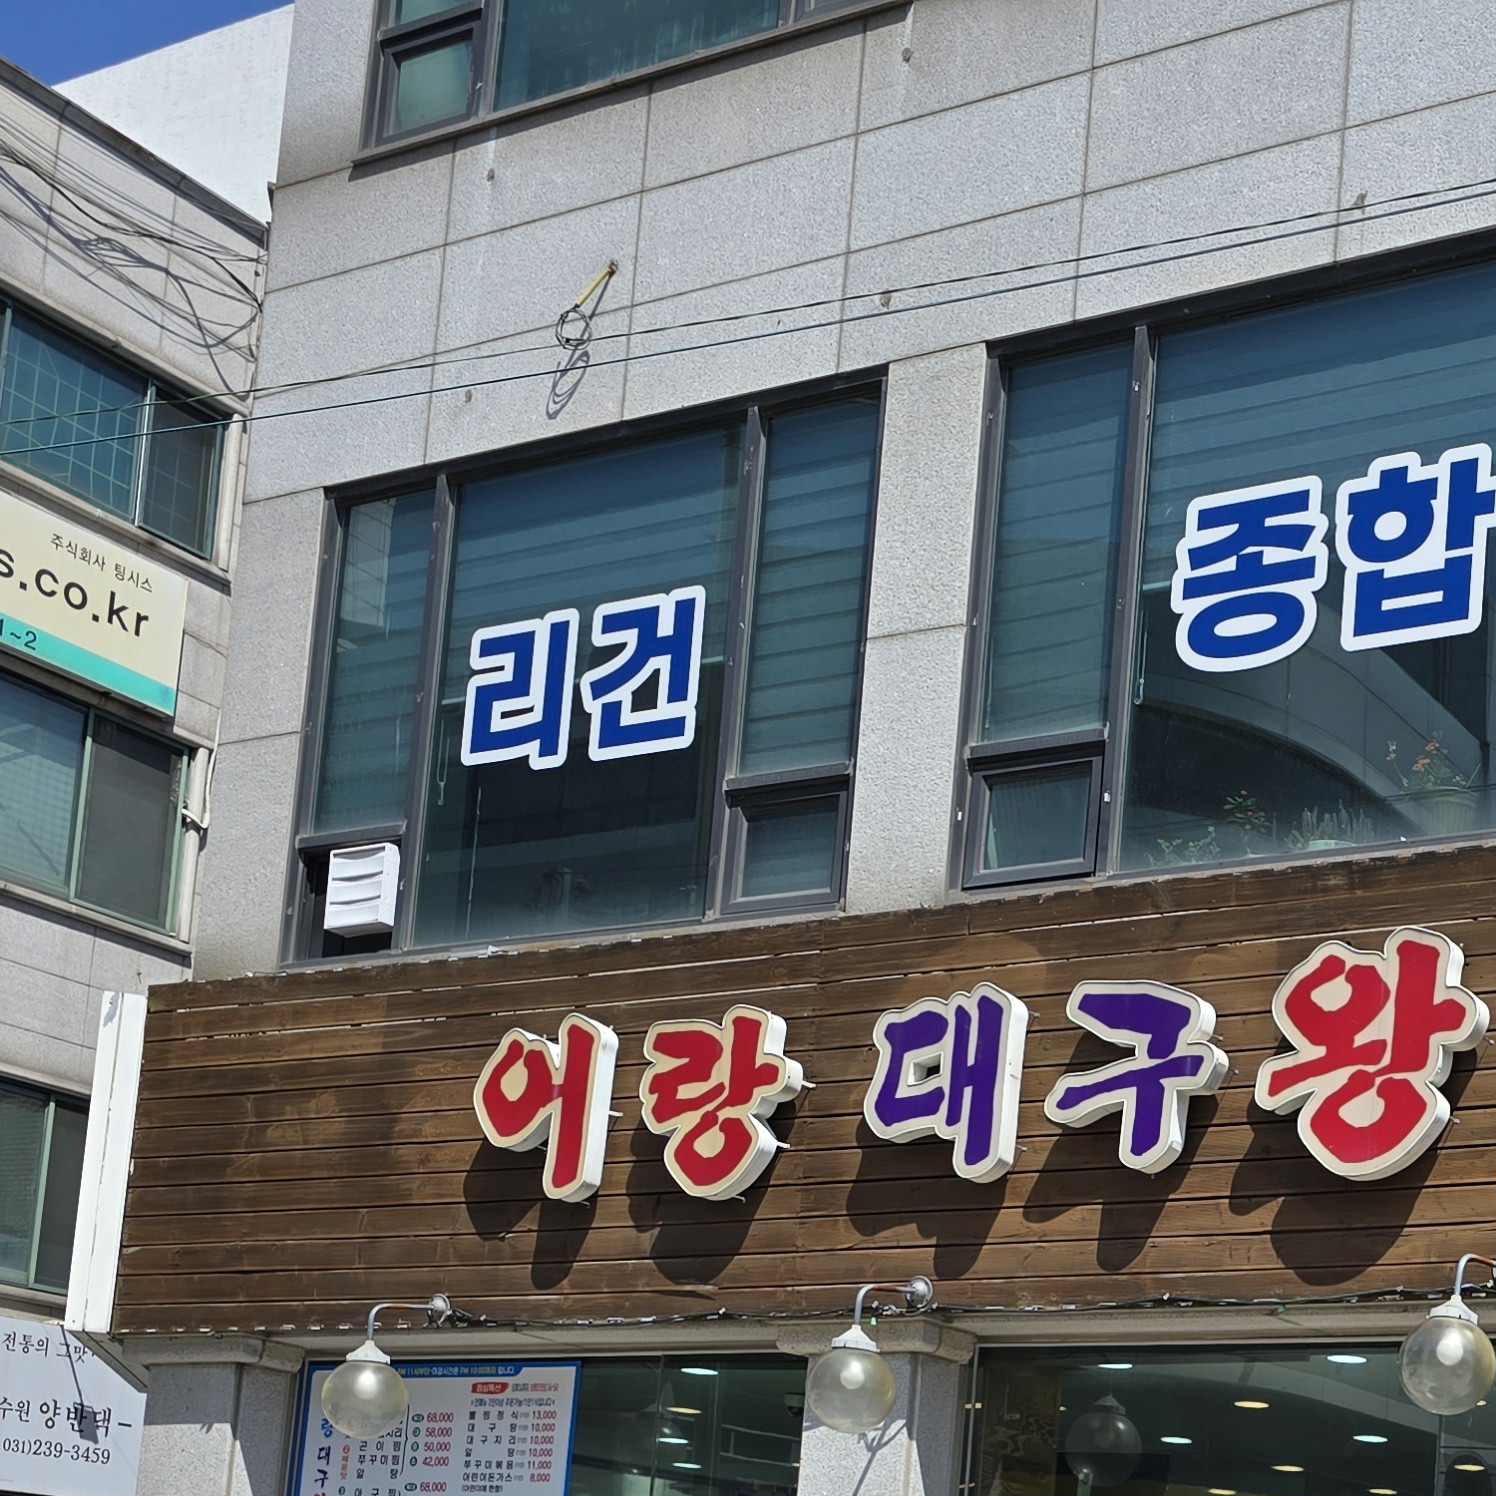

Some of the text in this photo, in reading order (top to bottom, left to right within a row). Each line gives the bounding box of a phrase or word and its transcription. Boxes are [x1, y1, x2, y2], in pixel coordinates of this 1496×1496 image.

[50, 533, 153, 593] 주식회사 팅시스
[463, 587, 704, 768] 리건
[2, 1331, 49, 1358] 전통의
[426, 1413, 454, 1424] 68,000
[532, 1411, 557, 1421] 13,000
[425, 1427, 453, 1438] 58,000
[531, 1423, 556, 1433] 10,000
[529, 1435, 554, 1445] 10,000
[423, 1441, 450, 1452] 50,000
[528, 1448, 553, 1458] 10,000
[422, 1456, 449, 1467] 42,000
[527, 1460, 552, 1471] 11,000
[529, 1473, 551, 1483] 8,000
[419, 1482, 446, 1492] 68,000
